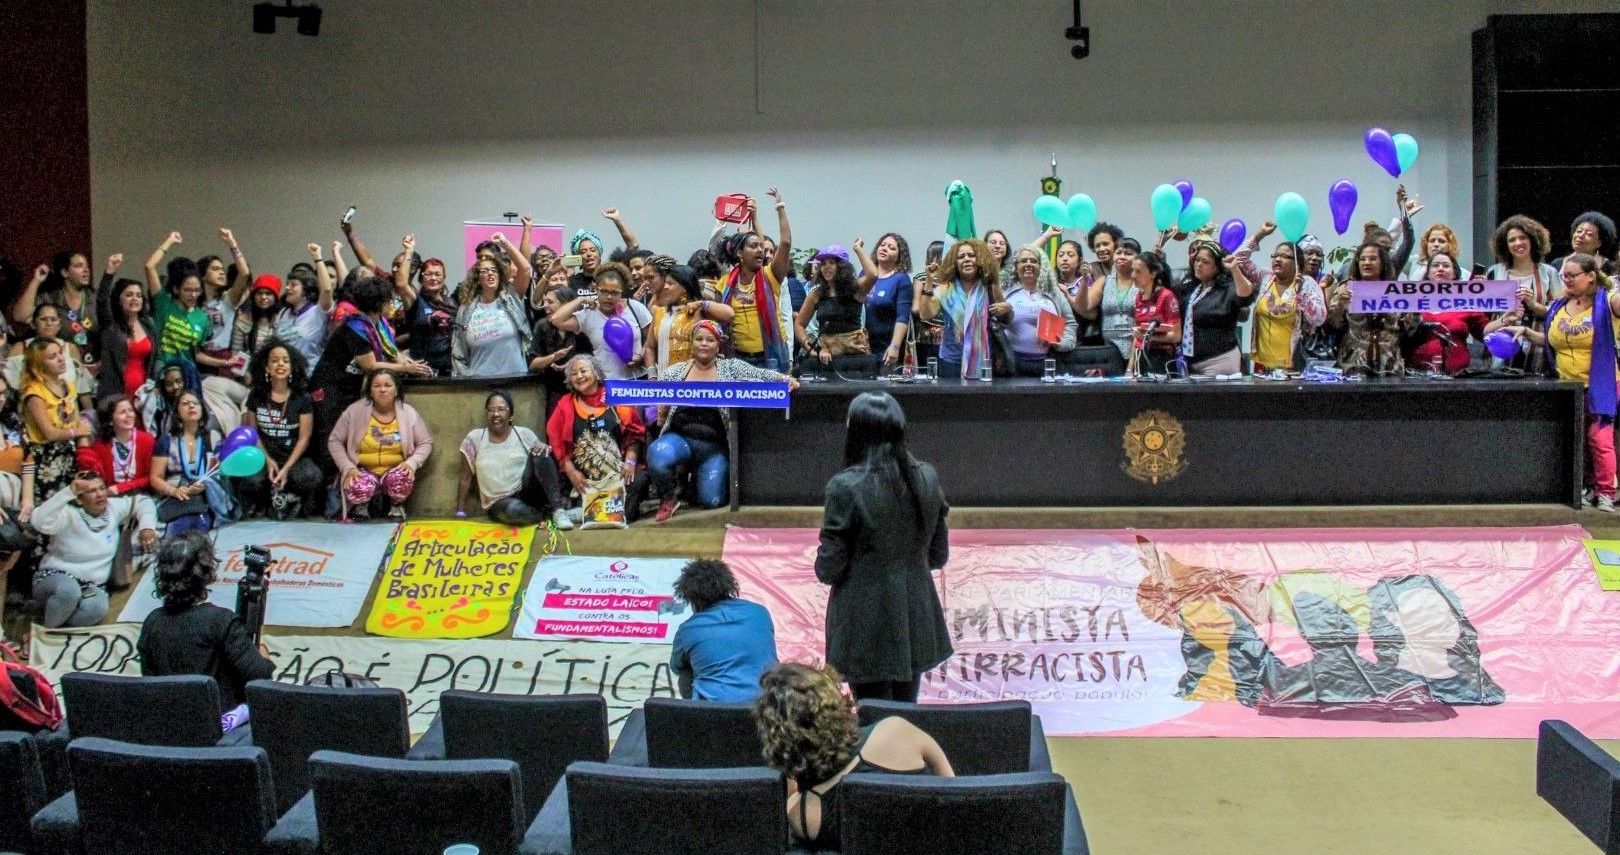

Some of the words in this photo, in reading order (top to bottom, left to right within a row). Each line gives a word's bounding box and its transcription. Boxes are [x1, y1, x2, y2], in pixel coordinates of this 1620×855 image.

[1384, 282, 1486, 295] ABORTO
[1361, 297, 1409, 311] NÃO
[1418, 296, 1430, 311] É
[1438, 299, 1509, 311] CRIME
[610, 387, 674, 398] FEMINISTAS
[676, 389, 723, 399] CONTRA
[724, 391, 734, 399] O
[736, 391, 786, 400] RACISMO
[402, 538, 524, 559] Articulação
[390, 560, 416, 577] de
[422, 558, 520, 578] Mulheres
[386, 579, 511, 599] Brasileiras
[579, 586, 592, 594] NA
[595, 586, 617, 595] LUTA
[564, 598, 609, 608] ESTADO
[544, 623, 659, 635] FUNDAMENTALISMOS!
